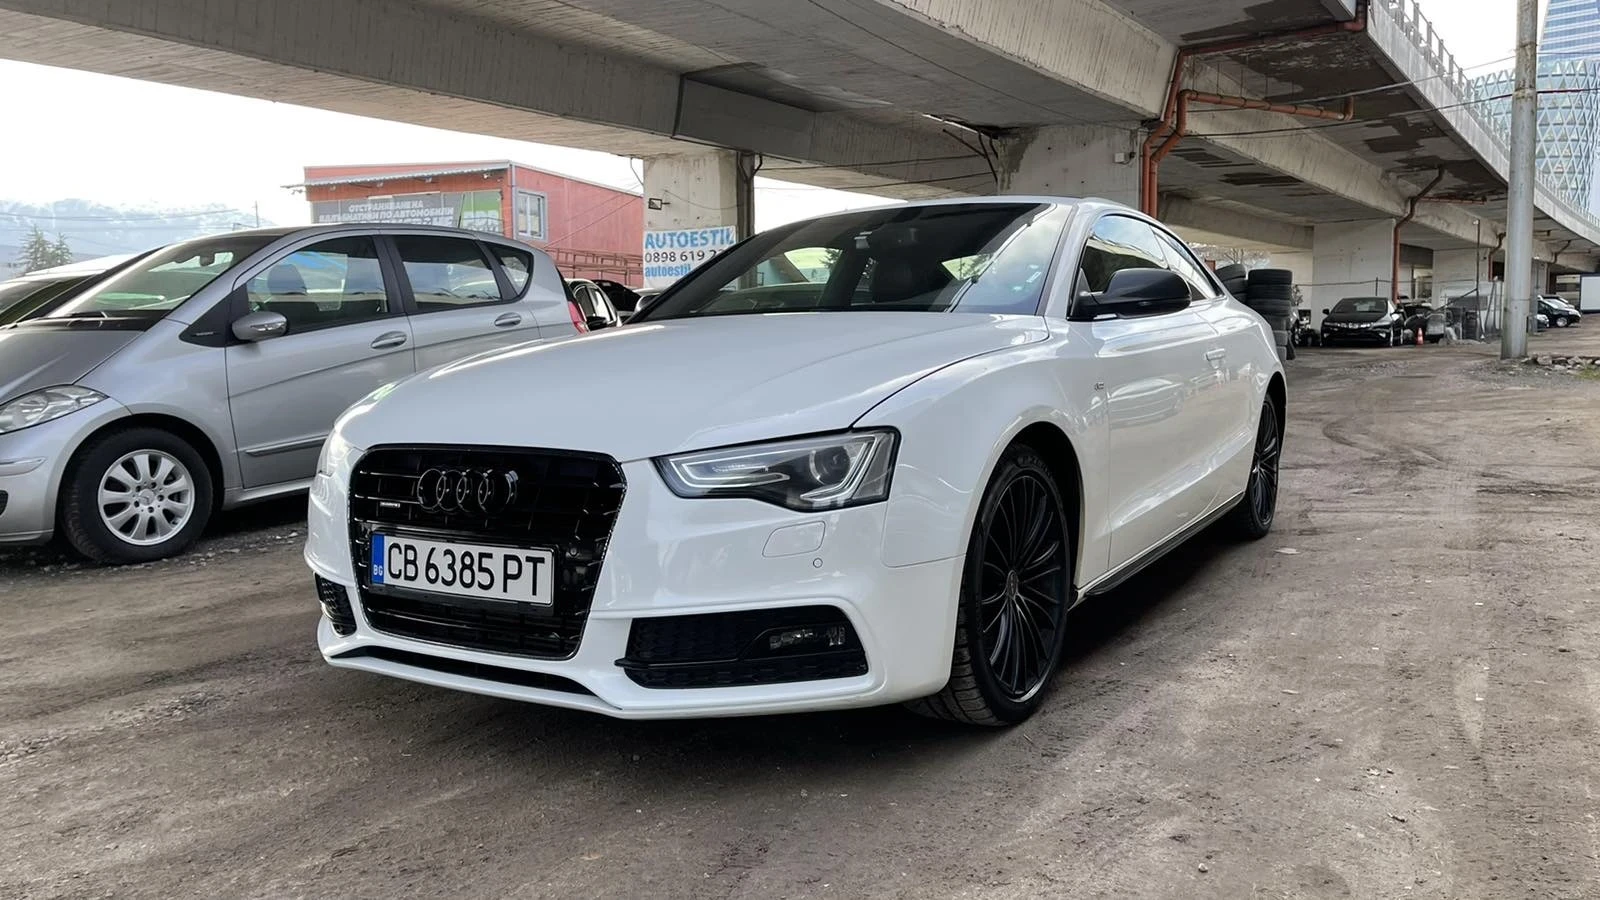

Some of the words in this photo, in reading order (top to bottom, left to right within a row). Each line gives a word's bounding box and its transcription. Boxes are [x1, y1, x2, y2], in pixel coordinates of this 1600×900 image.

[645, 228, 734, 249] AUTOESTIL
[644, 251, 677, 263] 0898
[680, 250, 705, 262] 619
[373, 564, 384, 577] BG
[387, 542, 419, 582] CB
[424, 546, 495, 591] 6385
[502, 554, 546, 597] PT
